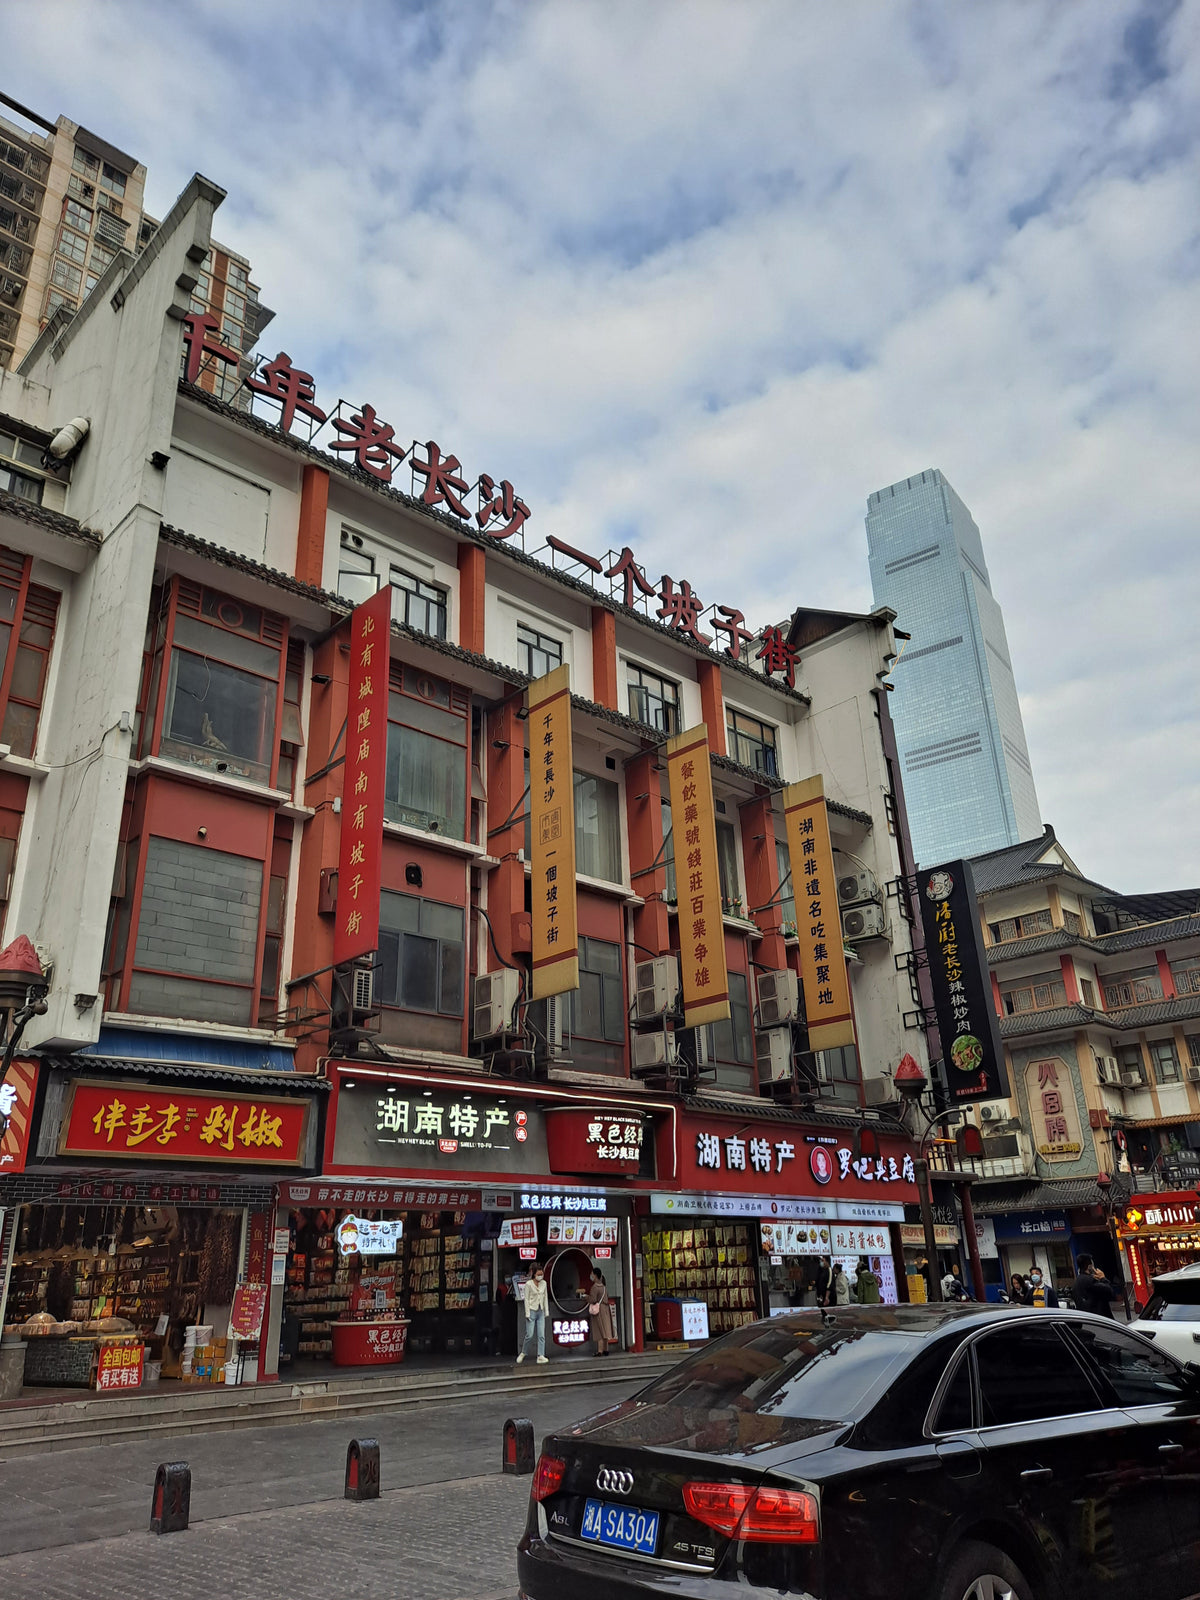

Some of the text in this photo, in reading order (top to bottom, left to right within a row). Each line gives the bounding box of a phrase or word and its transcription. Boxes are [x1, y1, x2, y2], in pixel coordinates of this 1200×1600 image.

[546, 535, 801, 688] 一个坡子街
[345, 616, 375, 936] 北有城隍庙南有坡子街
[542, 712, 555, 803] 千年老長沙
[545, 850, 559, 945] 一個坡子街
[799, 818, 834, 1005] 湖南非遺名吃集聚地
[199, 1105, 283, 1151] 剁椒
[376, 1097, 510, 1138] 湖南特产
[697, 1132, 795, 1173] 湖南特产
[318, 1188, 389, 1202] 带不走的长沙
[520, 1194, 561, 1210] 黑色经典
[1145, 1206, 1194, 1225] 酥小小
[101, 1366, 139, 1387] 有买有送
[102, 1347, 141, 1368] 全国包邮
[550, 1511, 570, 1526] A8L
[673, 1542, 715, 1556] 45 TFSI
